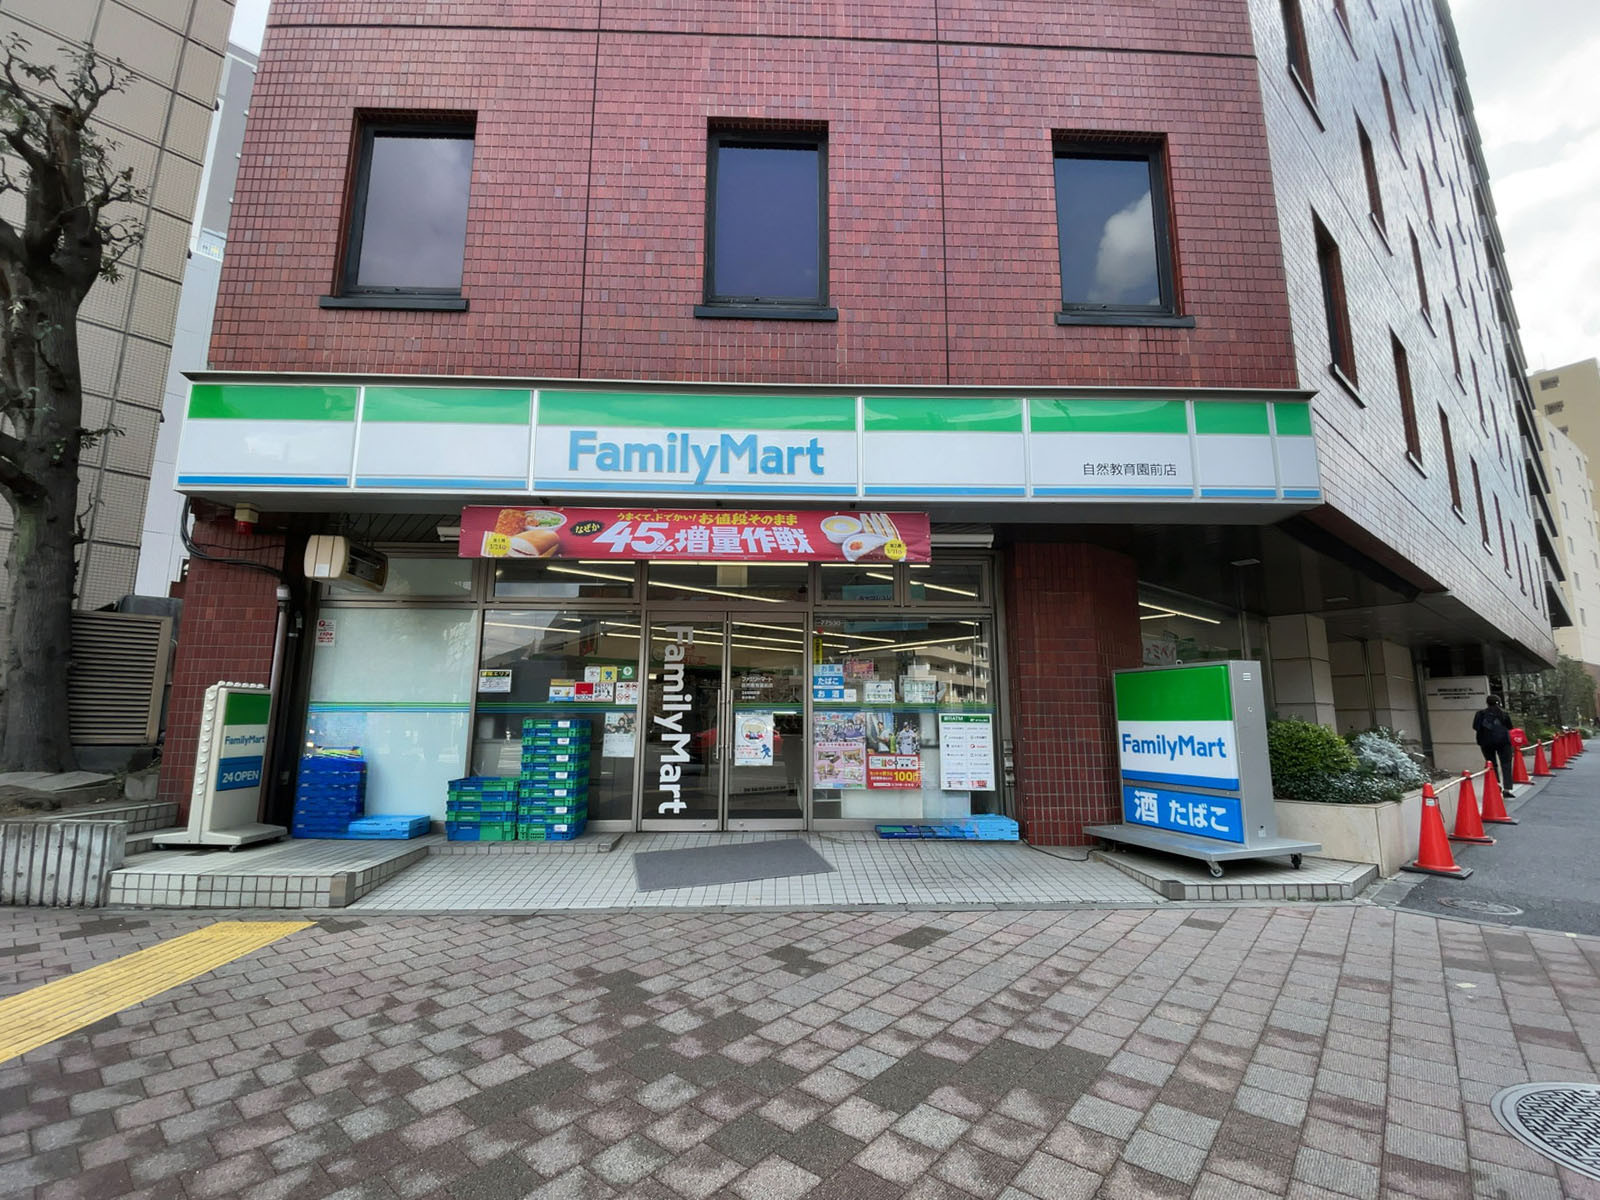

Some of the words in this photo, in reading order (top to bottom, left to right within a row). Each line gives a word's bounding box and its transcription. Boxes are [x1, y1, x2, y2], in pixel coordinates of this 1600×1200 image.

[568, 430, 824, 485] FamilyMart
[1083, 462, 1177, 476] 自然教育園前店
[698, 513, 798, 526] お値段そのまま
[575, 523, 601, 534] なぜか
[817, 677, 839, 685] たばこ
[653, 626, 694, 814] FamilyMart
[225, 735, 265, 746] FamilyMart
[1122, 733, 1227, 761] FamilyMart
[222, 772, 233, 784] 24
[234, 770, 259, 782] OPEN
[1134, 790, 1159, 824] 酒
[1169, 799, 1229, 833] たばこ
